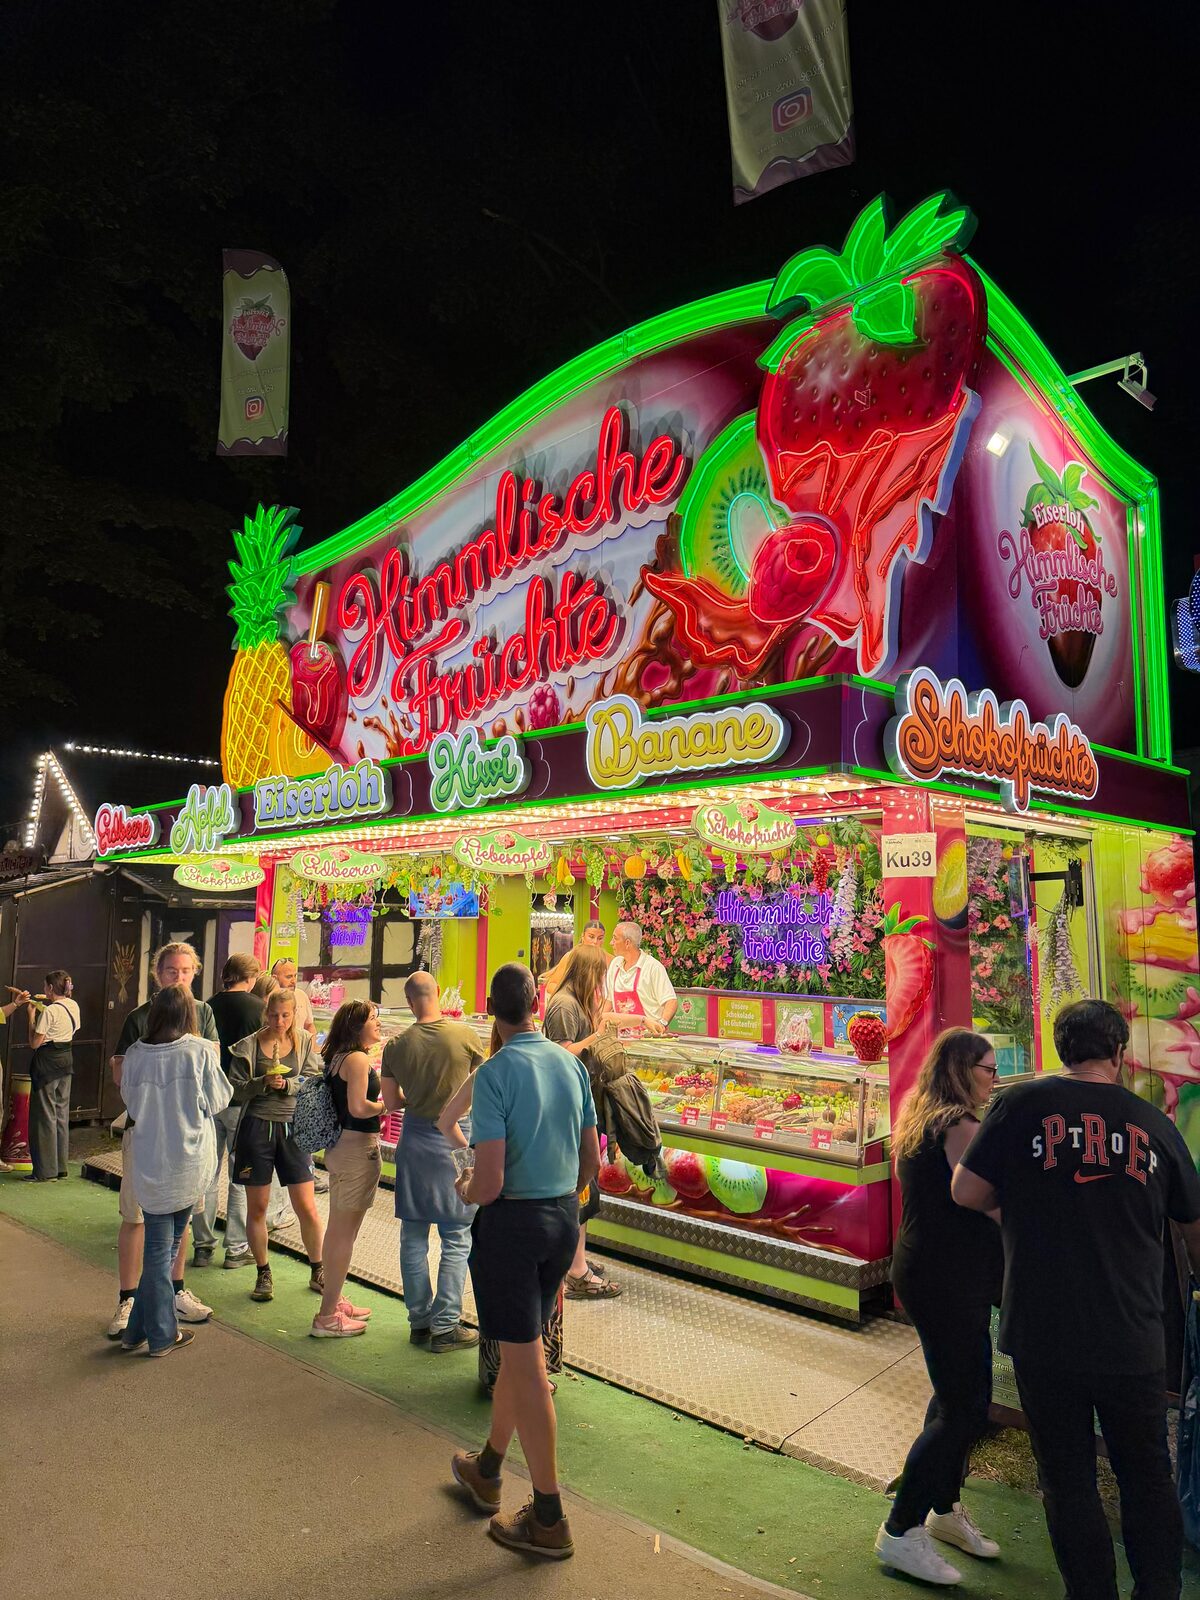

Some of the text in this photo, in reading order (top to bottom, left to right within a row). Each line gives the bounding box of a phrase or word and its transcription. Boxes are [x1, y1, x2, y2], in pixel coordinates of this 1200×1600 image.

[1031, 501, 1086, 537] Eiserloh
[338, 405, 688, 698] Himmlische
[997, 527, 1119, 600] Himmlische
[1031, 578, 1105, 641] Früchte
[391, 571, 620, 757] Früchte
[591, 702, 775, 780] Banane
[903, 678, 1098, 800] Schokofrüchte
[433, 733, 519, 803] Kiwi
[256, 763, 382, 823] Eiserloh
[97, 806, 153, 853] Erdbeere
[172, 785, 231, 853] Apfel
[706, 808, 796, 846] Schokofrüchte
[299, 853, 381, 877] Erdbeeren
[461, 836, 551, 870] Liebesapfel
[886, 850, 932, 868] Ku39
[183, 866, 264, 889] Schokofrüchte
[716, 891, 846, 925] Himmlisch
[743, 924, 825, 962] Früchte
[992, 1360, 1015, 1373] Ortenb
